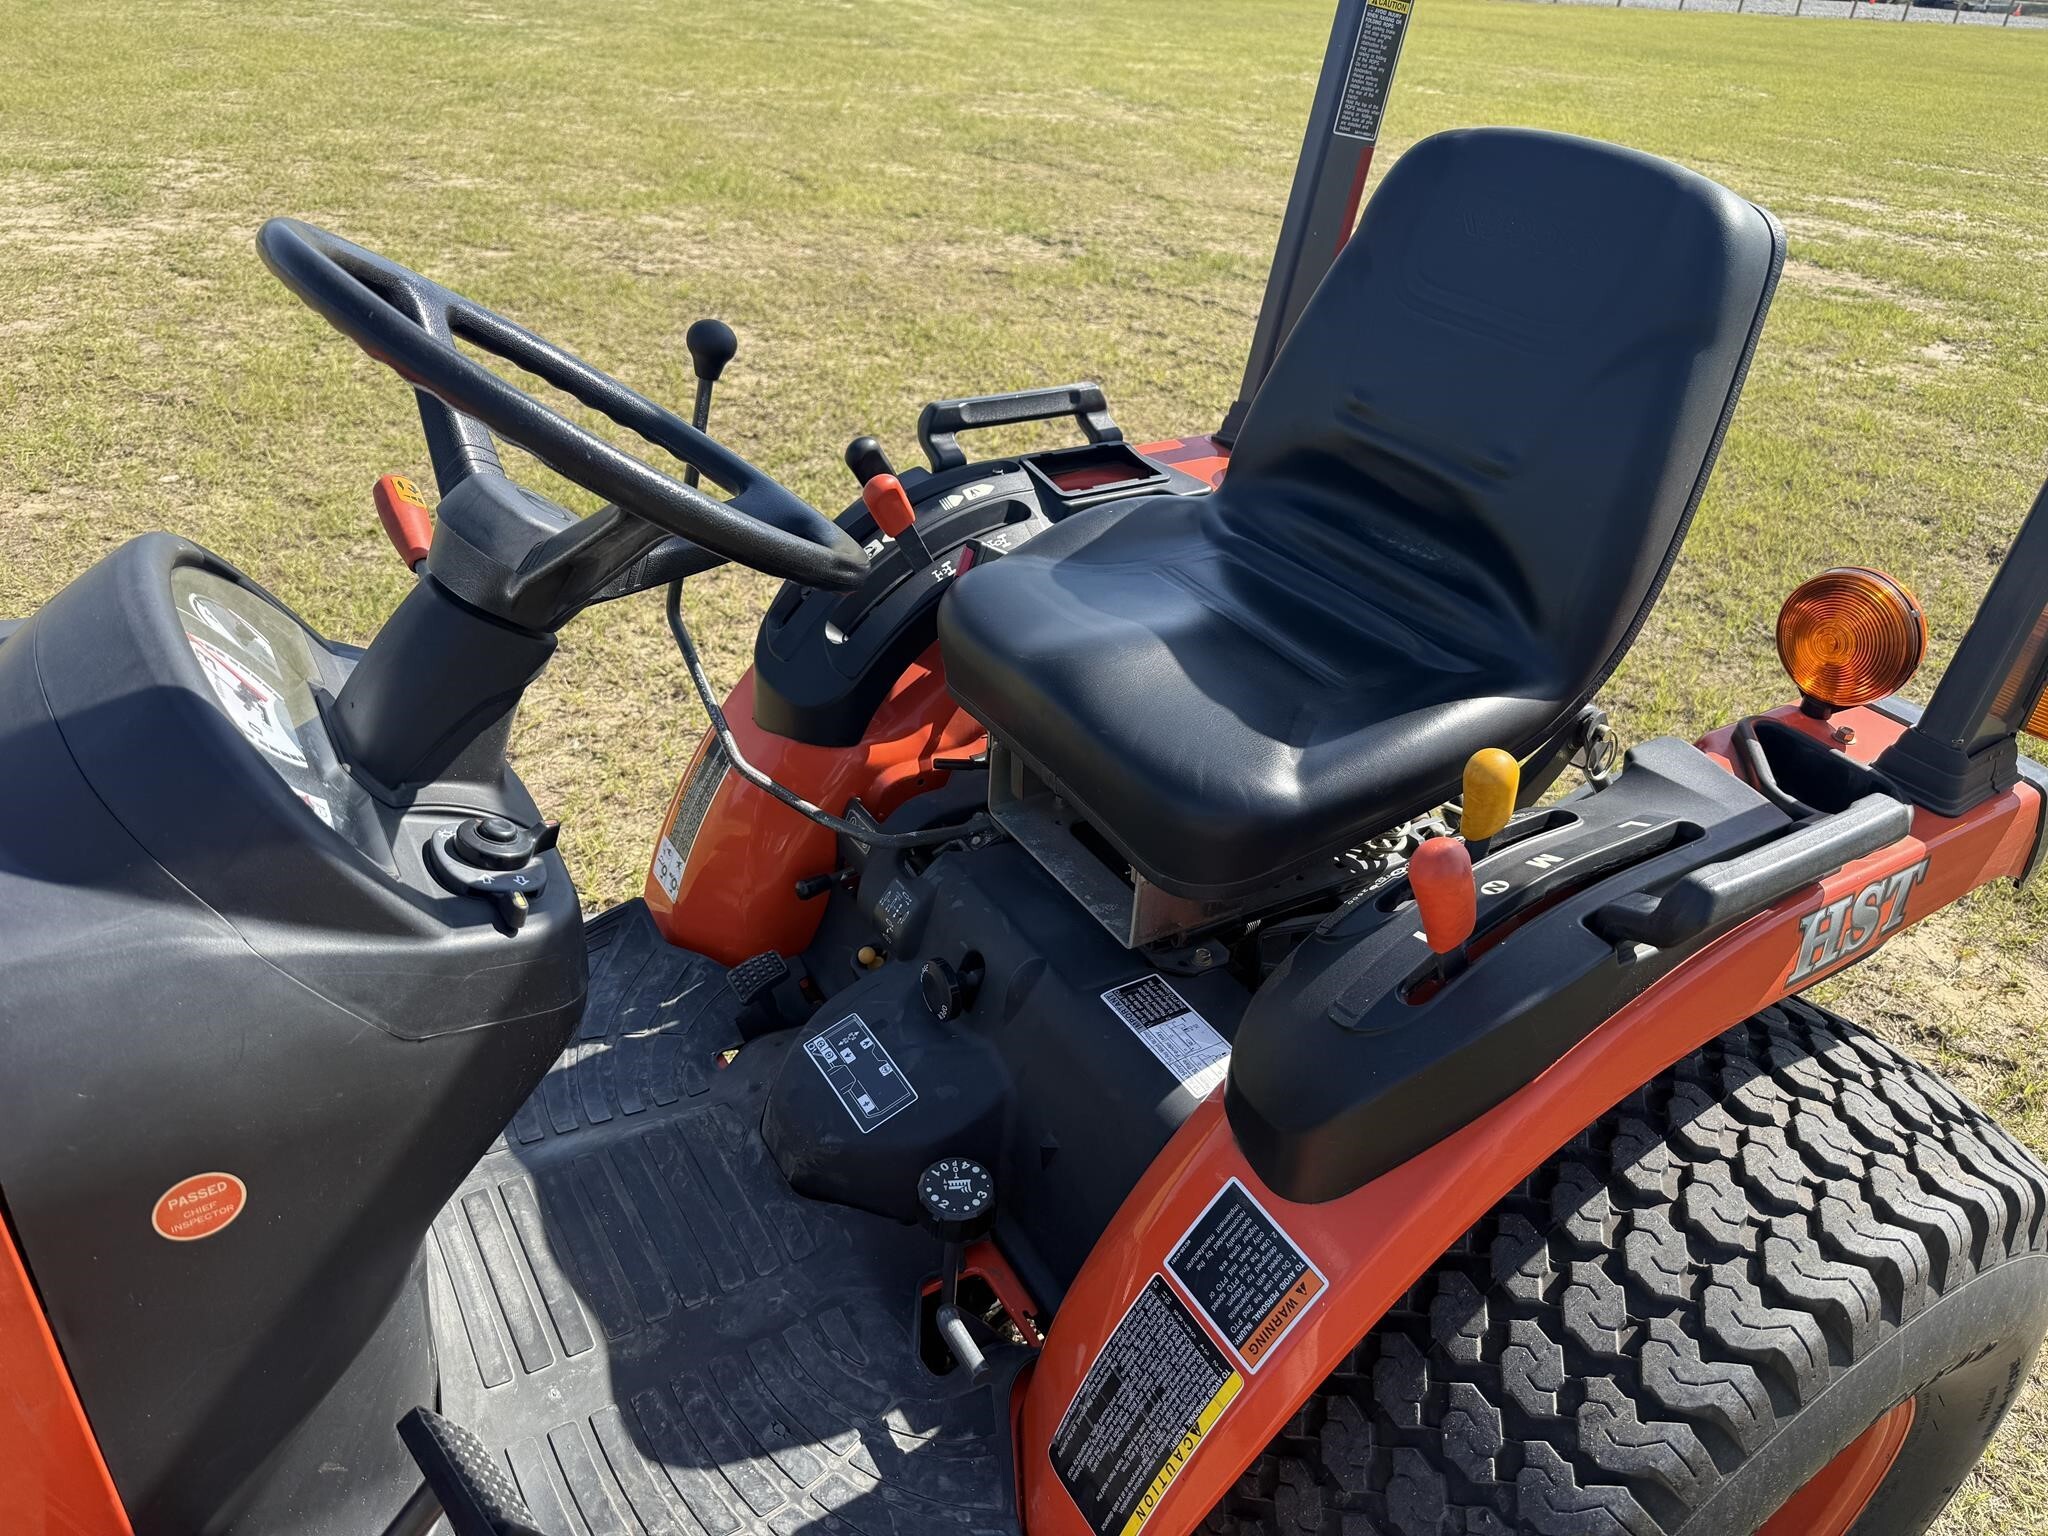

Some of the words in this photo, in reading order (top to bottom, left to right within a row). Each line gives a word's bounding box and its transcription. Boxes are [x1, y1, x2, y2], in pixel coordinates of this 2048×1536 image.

[1377, 0, 1407, 11] CAUTION
[1525, 853, 1565, 869] M
[1783, 855, 1931, 988] HST
[1104, 993, 1143, 1030] IMPORTANT
[168, 1181, 227, 1210] PASSED
[170, 1203, 234, 1232] INSPECTOR
[183, 1200, 216, 1218] CHIEF
[1214, 1202, 1240, 1233] implement
[1212, 1209, 1246, 1250] recommended
[1224, 1215, 1253, 1249] specifically
[1240, 1222, 1259, 1244] higher
[1252, 1230, 1265, 1246] only
[1227, 1243, 1242, 1260] rpms
[1259, 1237, 1271, 1252] Use
[1204, 1249, 1213, 1260] by
[1237, 1244, 1253, 1263] when
[1249, 1251, 1260, 1264] the
[1253, 1244, 1278, 1273] designed
[1266, 1251, 1284, 1273] speed
[1195, 1258, 1205, 1271] the
[1217, 1259, 1229, 1272] are
[1227, 1261, 1239, 1276] mid
[1238, 1263, 1250, 1277] 2nd
[1280, 1259, 1291, 1271] Do
[1293, 1259, 1304, 1272] TO
[1214, 1274, 1228, 1291] PTO
[1244, 1271, 1255, 1284] for
[1254, 1271, 1268, 1287] with
[1272, 1268, 1283, 1282] not
[1278, 1269, 1296, 1291] AVOID
[1225, 1276, 1239, 1292] PTO
[1262, 1279, 1274, 1293] use
[1207, 1289, 1216, 1300] or
[1209, 1291, 1227, 1311] speed
[1227, 1285, 1256, 1320] implements
[1253, 1292, 1264, 1305] the
[1241, 1304, 1254, 1318] 2nd
[1251, 1289, 1280, 1323] PERSONAL
[1229, 1317, 1243, 1334] PTO
[1231, 1321, 1253, 1347] INJURY:
[1247, 1295, 1298, 1357] WARNING
[1220, 1367, 1230, 1380] TO
[1206, 1376, 1224, 1399] AVOID
[1183, 1394, 1210, 1429] PERSONAL
[1167, 1424, 1187, 1451] INJURY:
[1134, 1435, 1194, 1521] CAUTION
